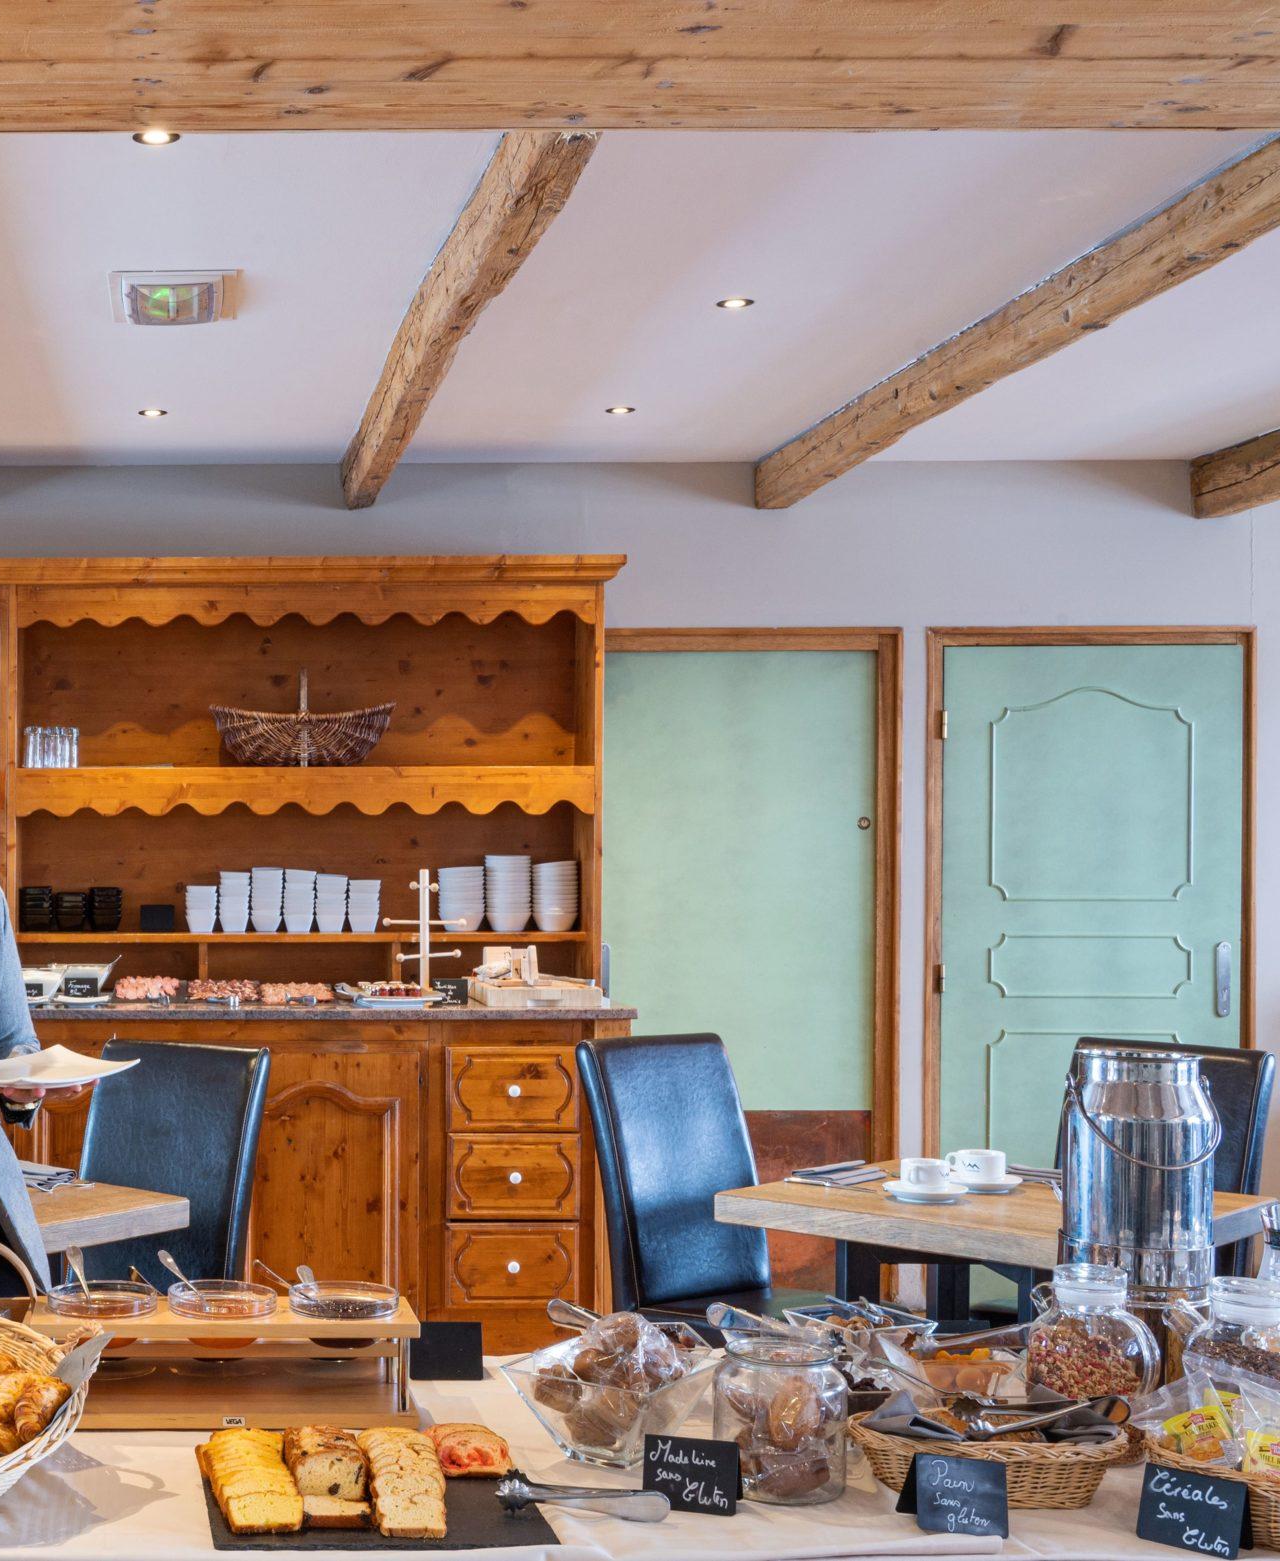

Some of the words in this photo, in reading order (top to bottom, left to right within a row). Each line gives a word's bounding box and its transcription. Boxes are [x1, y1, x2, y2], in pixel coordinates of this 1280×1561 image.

[649, 1439, 716, 1468] Madeleine
[931, 1459, 975, 1493] Pain
[1150, 1468, 1228, 1509] Céréales
[682, 1477, 729, 1509] Gluten
[947, 1507, 991, 1532] gluten
[1182, 1526, 1230, 1556] Gluten
